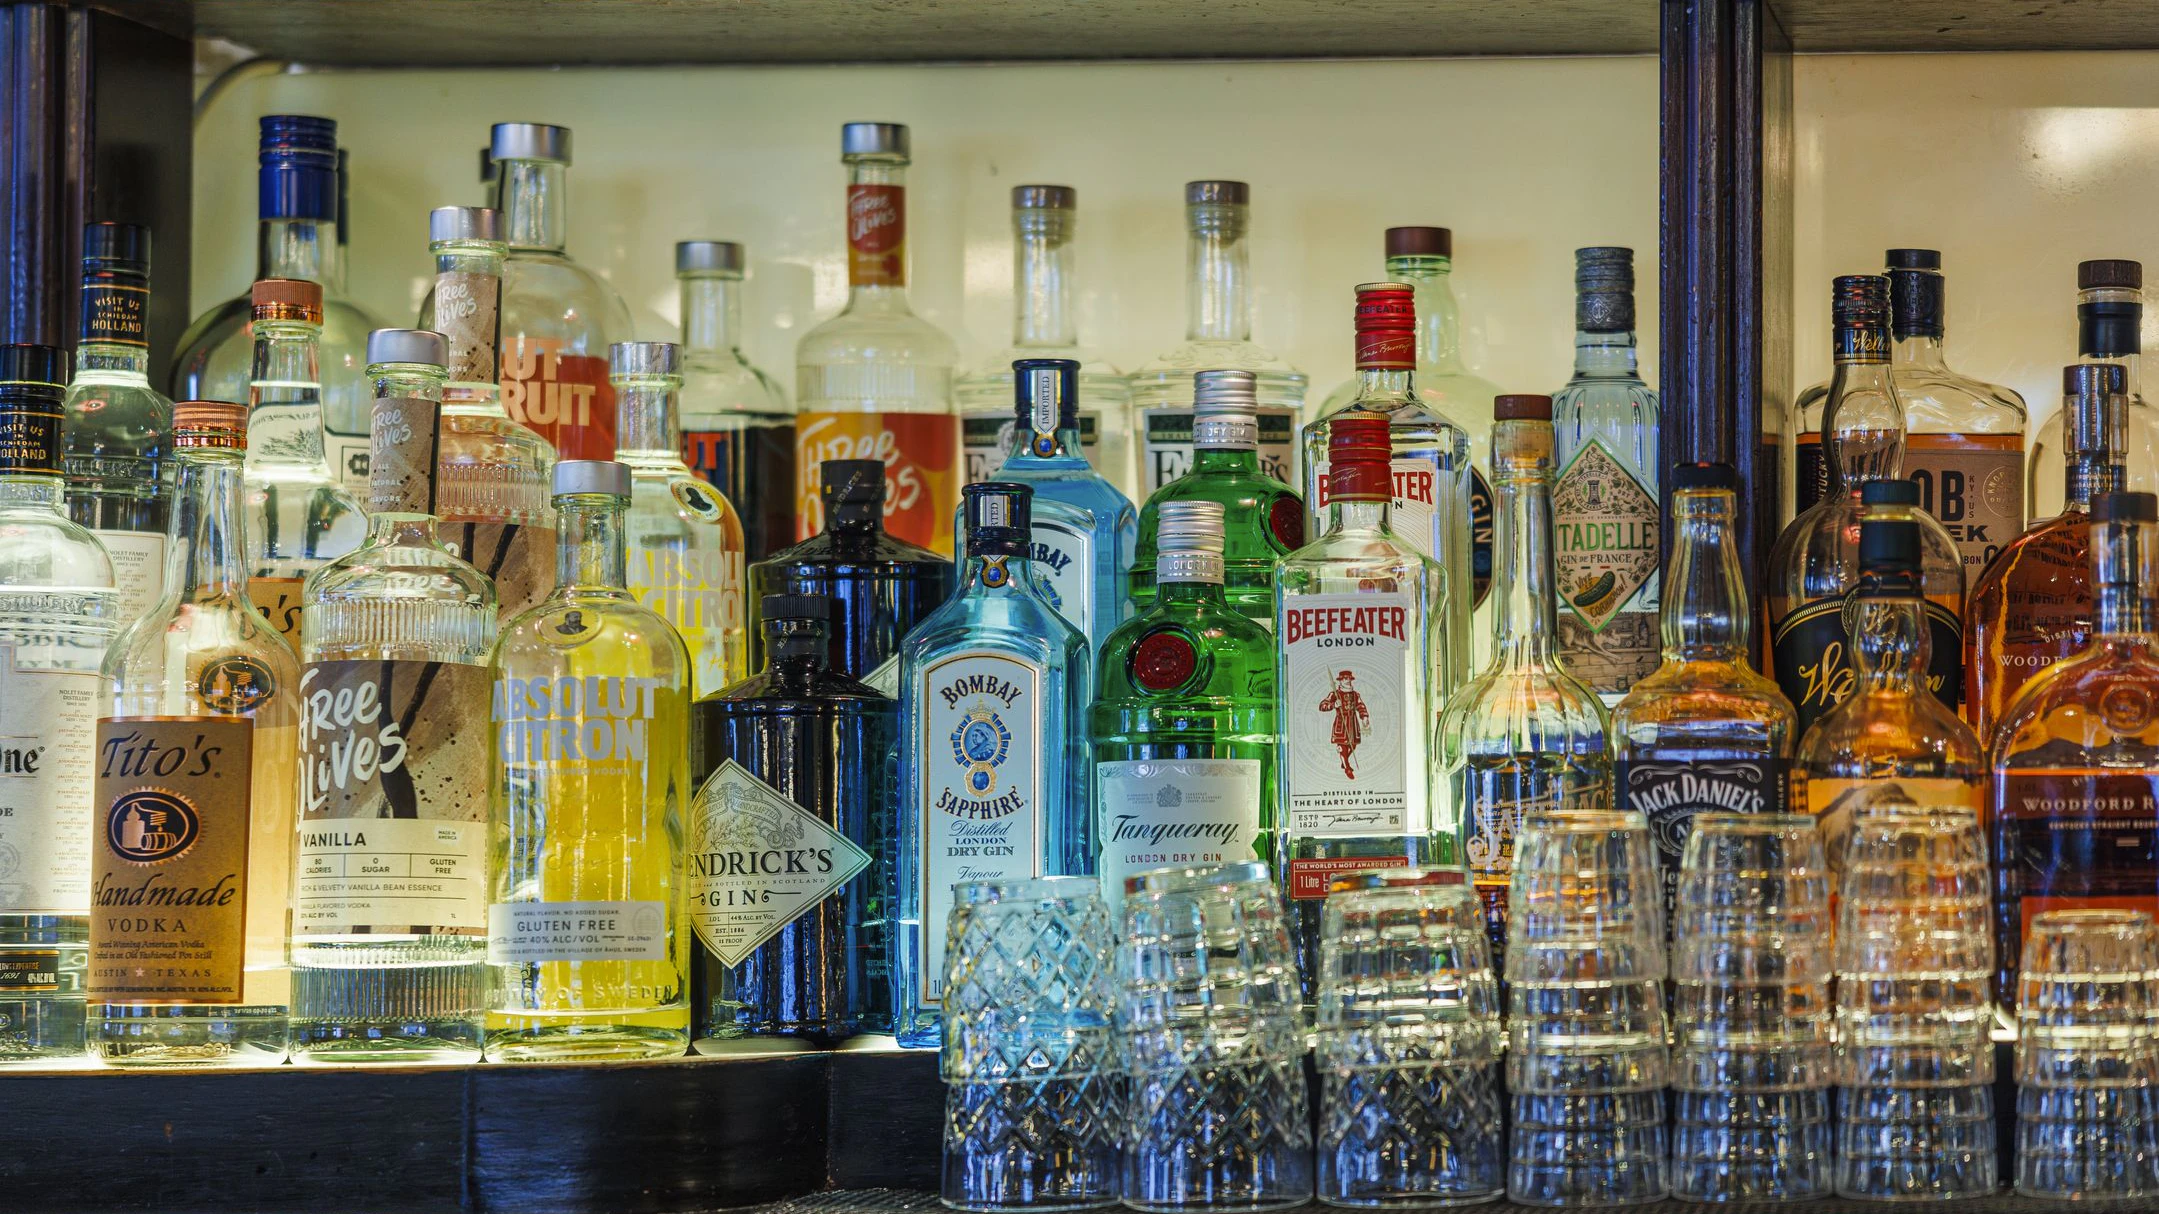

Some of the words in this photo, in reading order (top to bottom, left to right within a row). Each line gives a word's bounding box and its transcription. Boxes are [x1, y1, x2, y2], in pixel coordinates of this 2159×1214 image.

[94, 297, 123, 307] VISIT
[128, 300, 140, 311] US
[98, 312, 137, 321] SCHIEDAM
[92, 320, 142, 333] HOLLAND
[1041, 376, 1050, 425] IMPORTED
[30, 425, 45, 437] US
[0, 449, 46, 461] OLLAND
[1561, 554, 1577, 564] GIN
[1590, 553, 1632, 564] FRANCE
[1287, 607, 1406, 645] BEEFEATER
[1317, 637, 1374, 648] LONDON
[940, 675, 1023, 710] BOMBAY
[491, 677, 661, 722] ABSOLUT
[500, 719, 644, 763] CITRON
[101, 731, 221, 779] Tito's
[1628, 779, 1677, 816] JACK
[1681, 773, 1765, 814] DANIEL'S
[936, 785, 1024, 820] SAPPHIRE
[1314, 799, 1344, 807] HEART
[1362, 797, 1402, 805] LONDON
[2022, 797, 2135, 812] WOODFORD
[949, 819, 1014, 837] Distilled
[1112, 814, 1239, 846] Tanqueray
[303, 833, 366, 847] VANILLA
[955, 836, 1007, 845] LONDON
[947, 847, 981, 857] DRY
[983, 846, 1014, 856] GIN
[1125, 855, 1166, 863] LONDON
[1172, 853, 1196, 862] DRY
[1203, 853, 1222, 862] GIN
[430, 858, 457, 866] GLUTEN
[690, 849, 833, 877] ENDRICK'S
[305, 866, 332, 874] CALORIES
[435, 867, 451, 875] FREE
[957, 866, 1003, 880] Vapour
[318, 884, 346, 892] VELVETY
[408, 884, 443, 892] ESSENCE
[1305, 876, 1320, 888] Litre
[92, 872, 235, 906] Handmade
[710, 890, 757, 907] GIN
[108, 918, 187, 933] VODKA
[517, 920, 571, 932] GLUTEN
[579, 919, 616, 931] FREE
[180, 940, 205, 948] Vodka
[530, 936, 549, 944] 40%
[552, 935, 600, 944] ALC/VOL
[93, 968, 128, 977] AUSTIN
[155, 968, 212, 977] TEXAS
